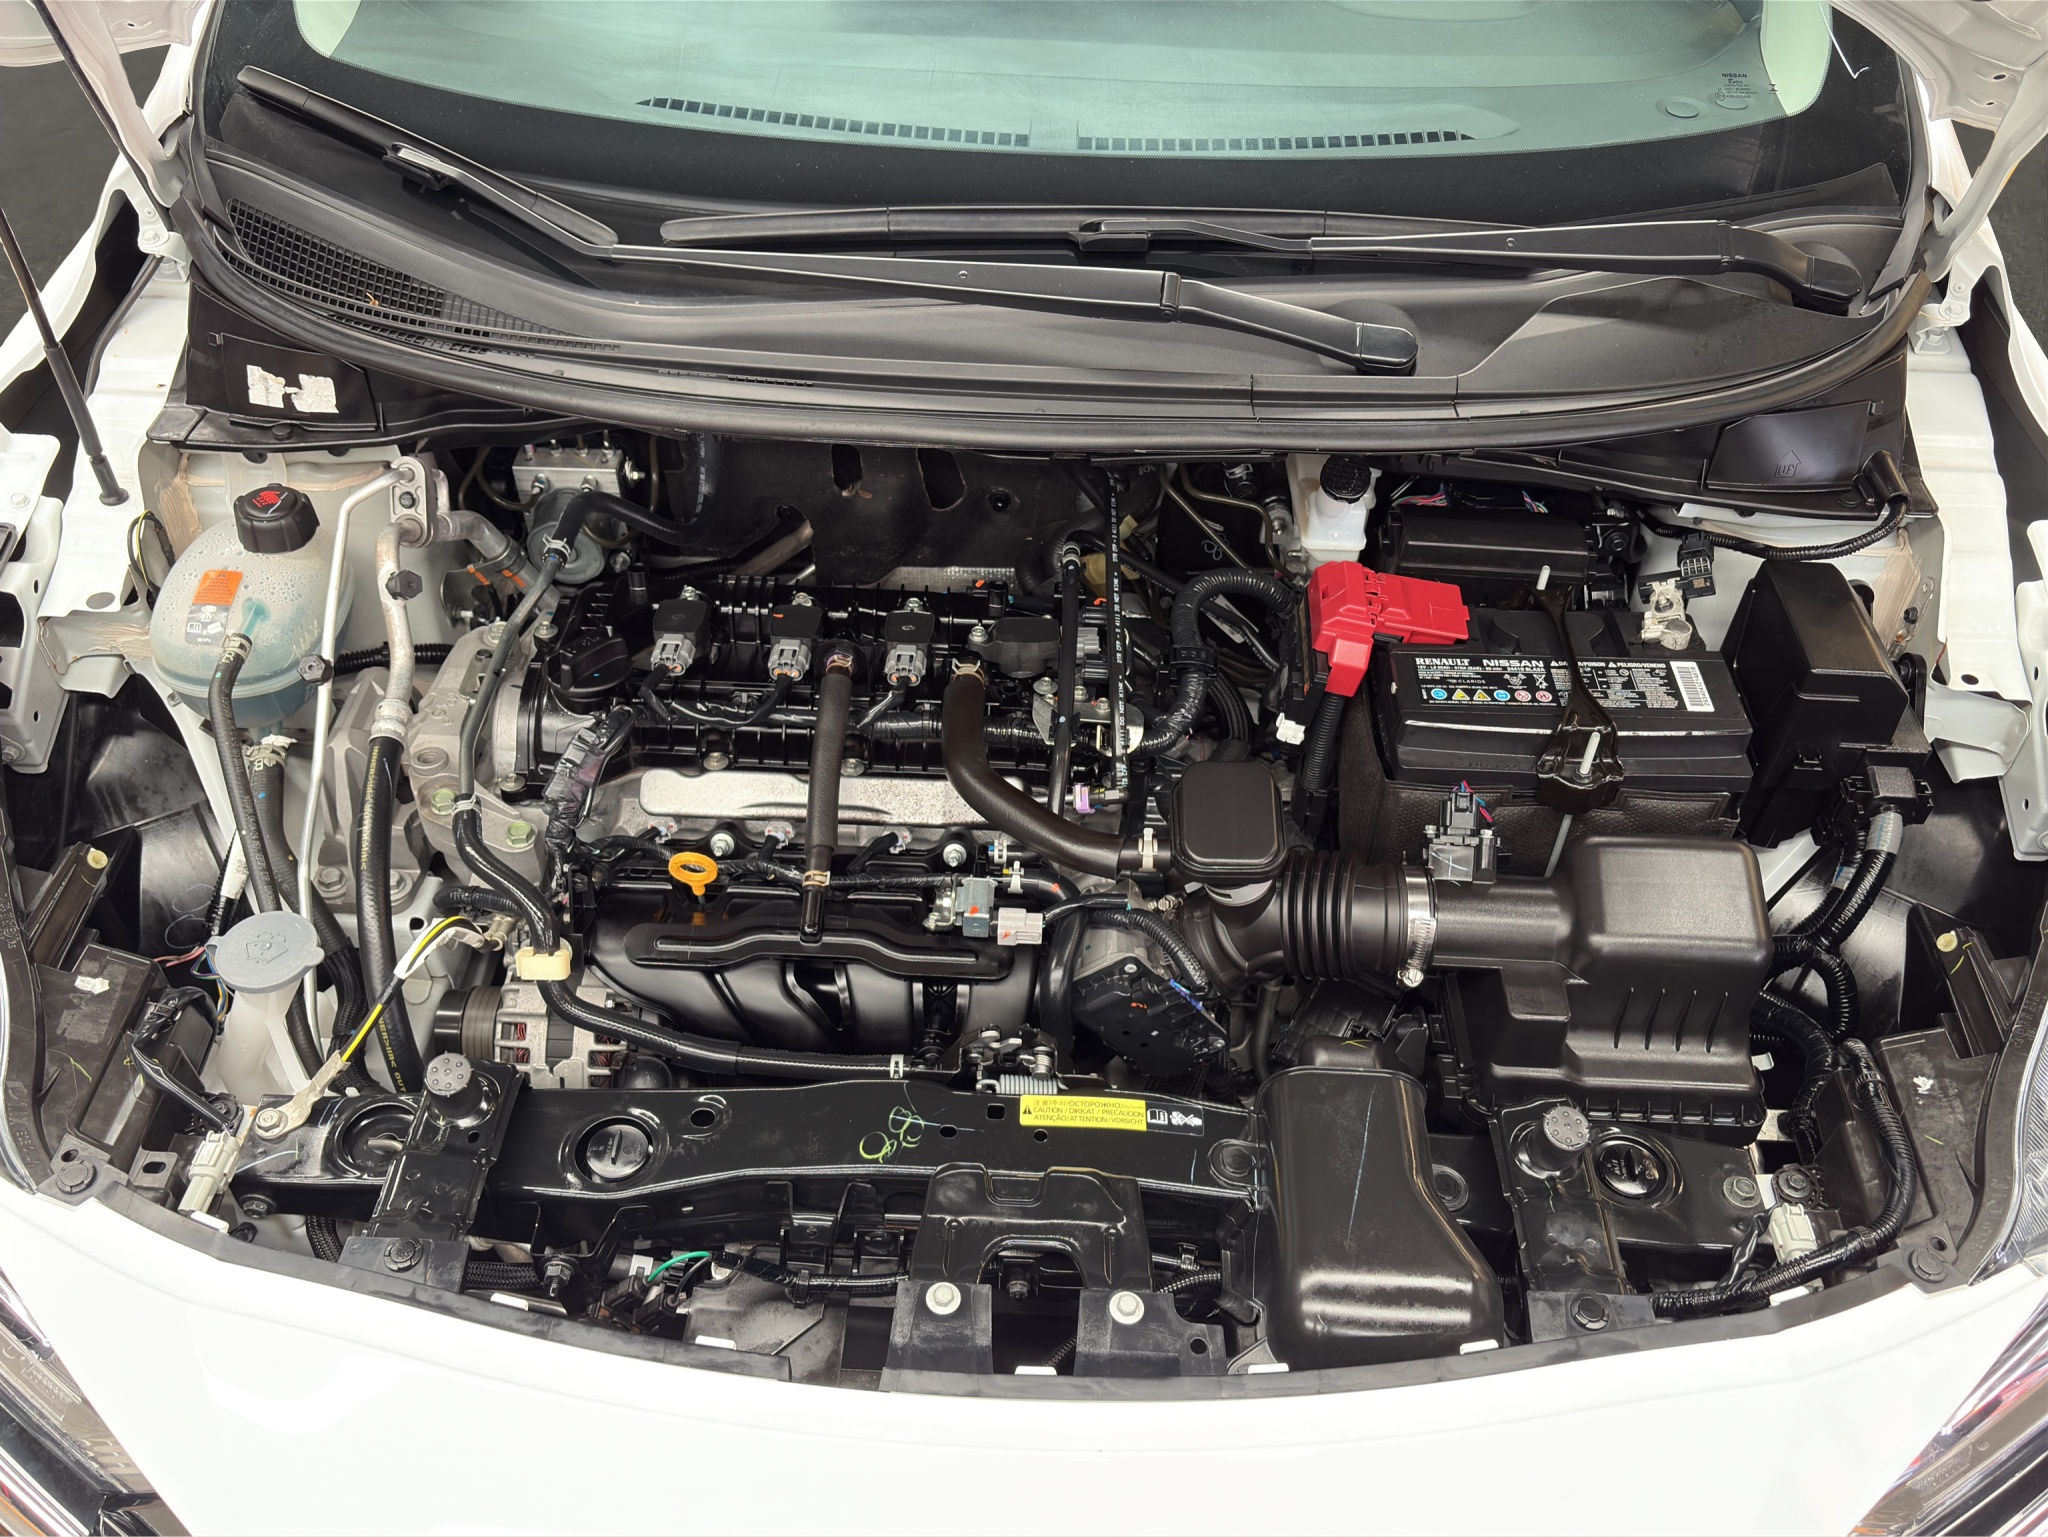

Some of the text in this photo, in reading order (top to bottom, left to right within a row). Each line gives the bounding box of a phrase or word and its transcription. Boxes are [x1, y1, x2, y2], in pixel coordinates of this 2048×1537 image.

[1114, 604, 1120, 612] DO
[1415, 657, 1545, 667] RENAULT NISSAN
[1119, 717, 1125, 726] DO
[1033, 1106, 1063, 1115] CAUTION
